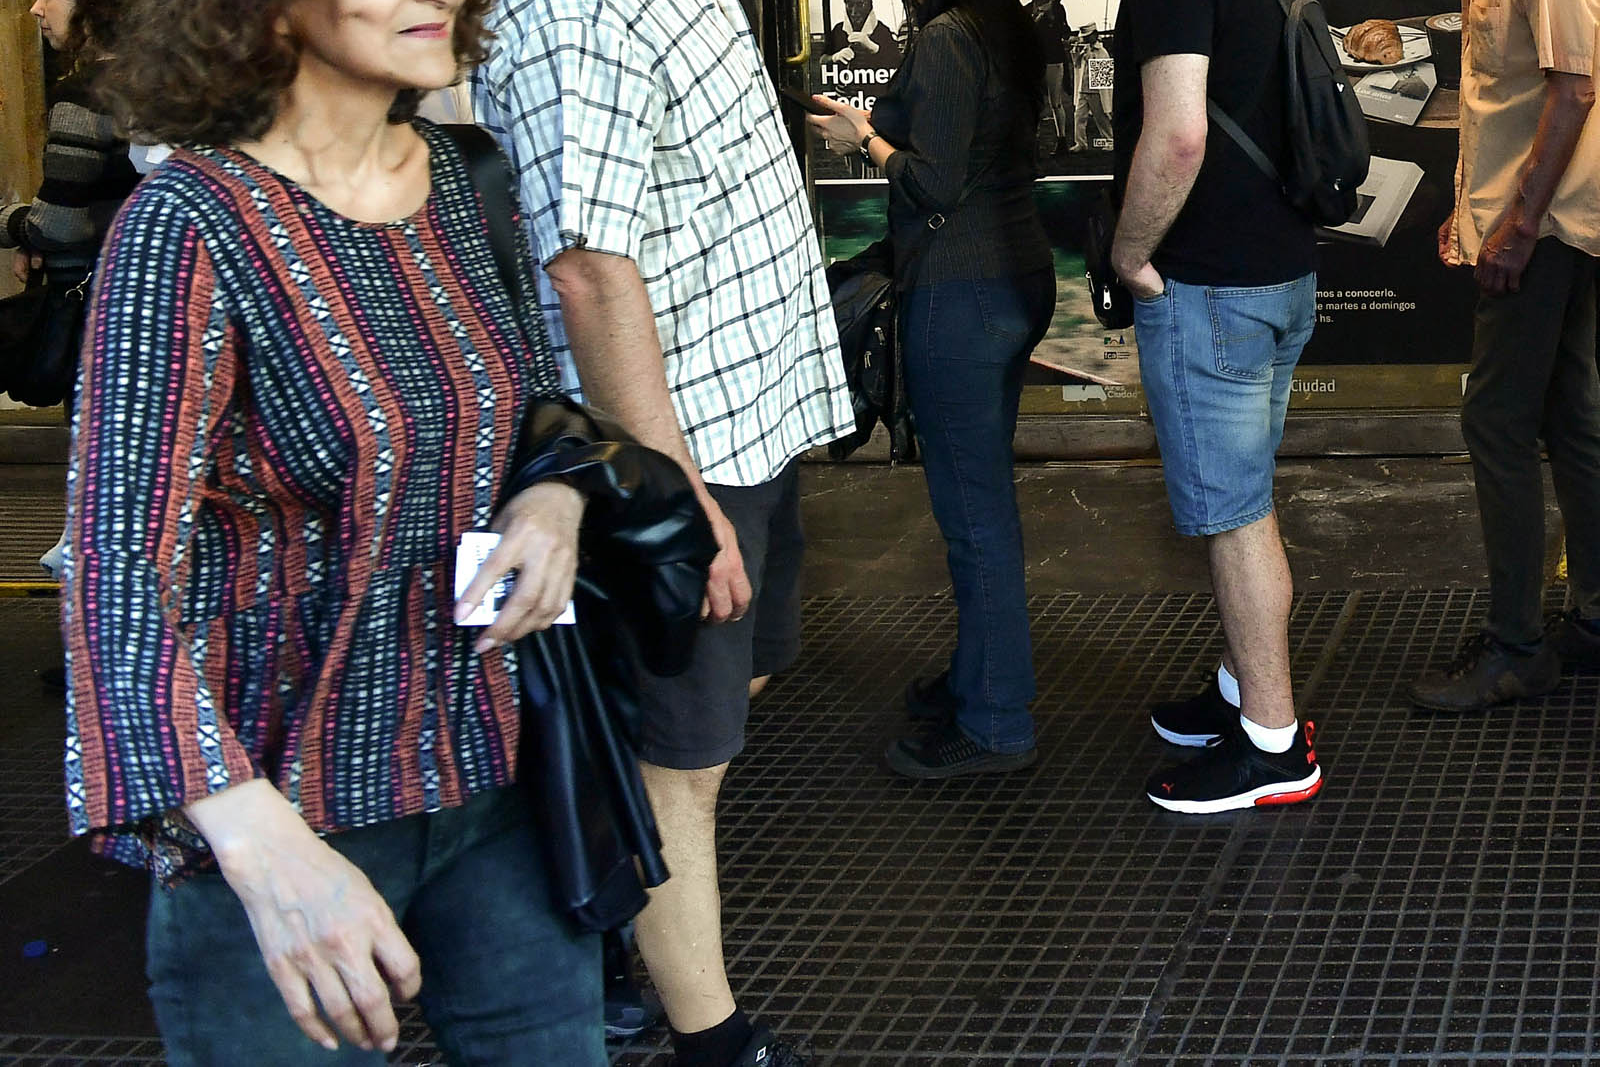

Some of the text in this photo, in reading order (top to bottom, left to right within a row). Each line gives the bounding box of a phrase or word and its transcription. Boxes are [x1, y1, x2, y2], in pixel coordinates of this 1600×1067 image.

[1345, 289, 1397, 298] conocerlo.
[1326, 302, 1359, 310] martes
[1369, 301, 1416, 312] domingos
[1320, 314, 1334, 323] hs.
[1291, 379, 1335, 392] Ciudad
